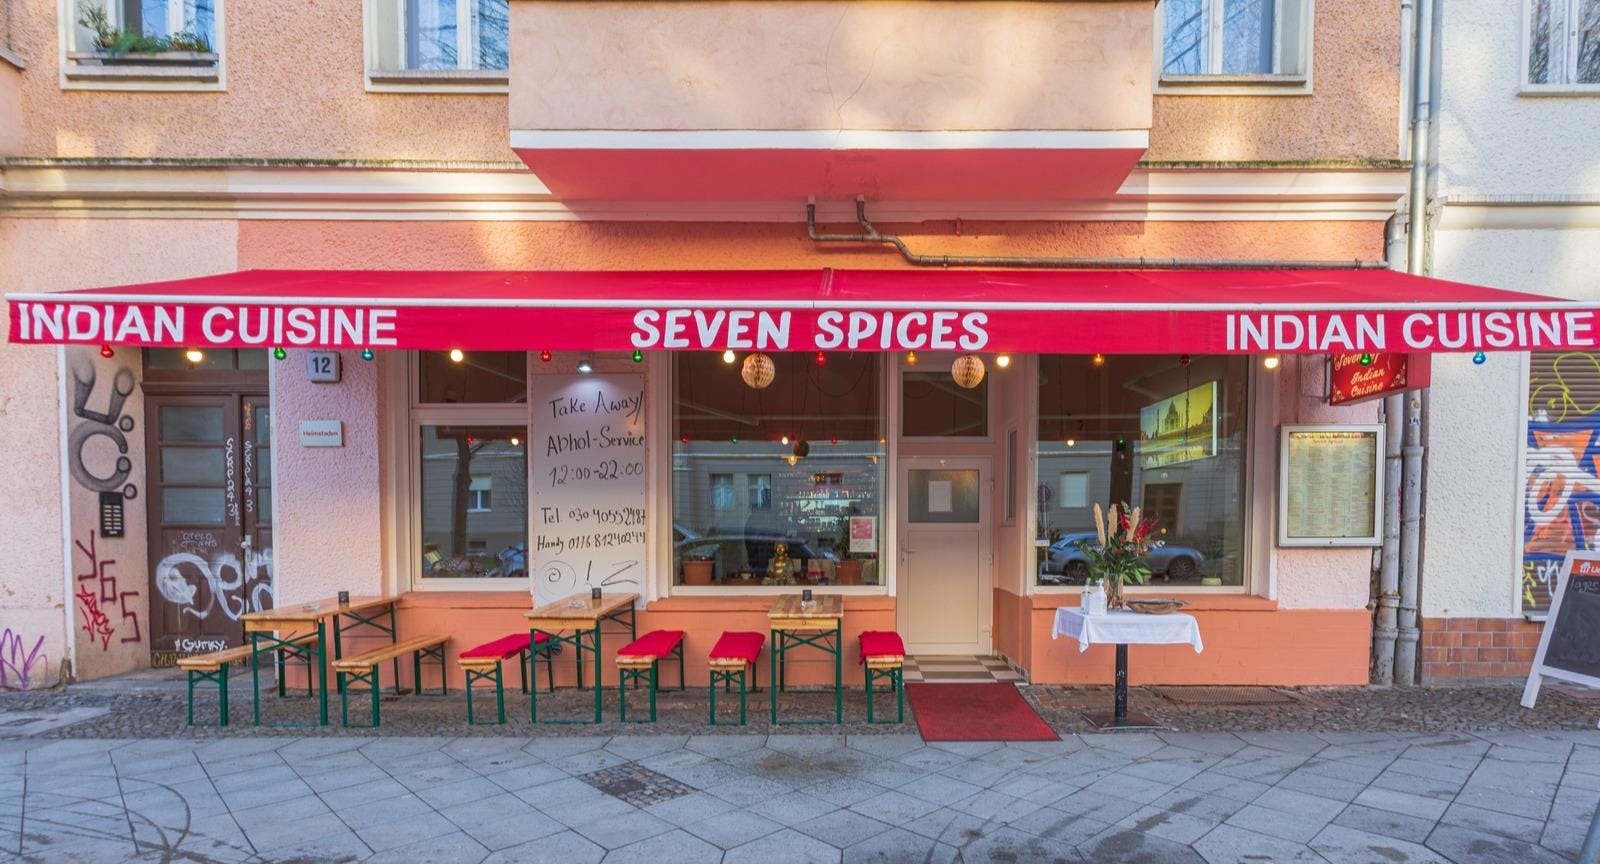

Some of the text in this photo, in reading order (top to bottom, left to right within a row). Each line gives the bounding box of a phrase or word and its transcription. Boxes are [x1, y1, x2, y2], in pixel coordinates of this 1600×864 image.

[18, 302, 397, 345] INDIAN CUISINE
[630, 309, 989, 350] SEVEN SPICES
[1226, 311, 1595, 350] INDIAN CUISINE
[312, 356, 331, 374] 12
[1350, 367, 1385, 385] Indian
[1350, 380, 1384, 398] Cuisine
[548, 397, 586, 418] Take
[537, 534, 565, 556] Handy
